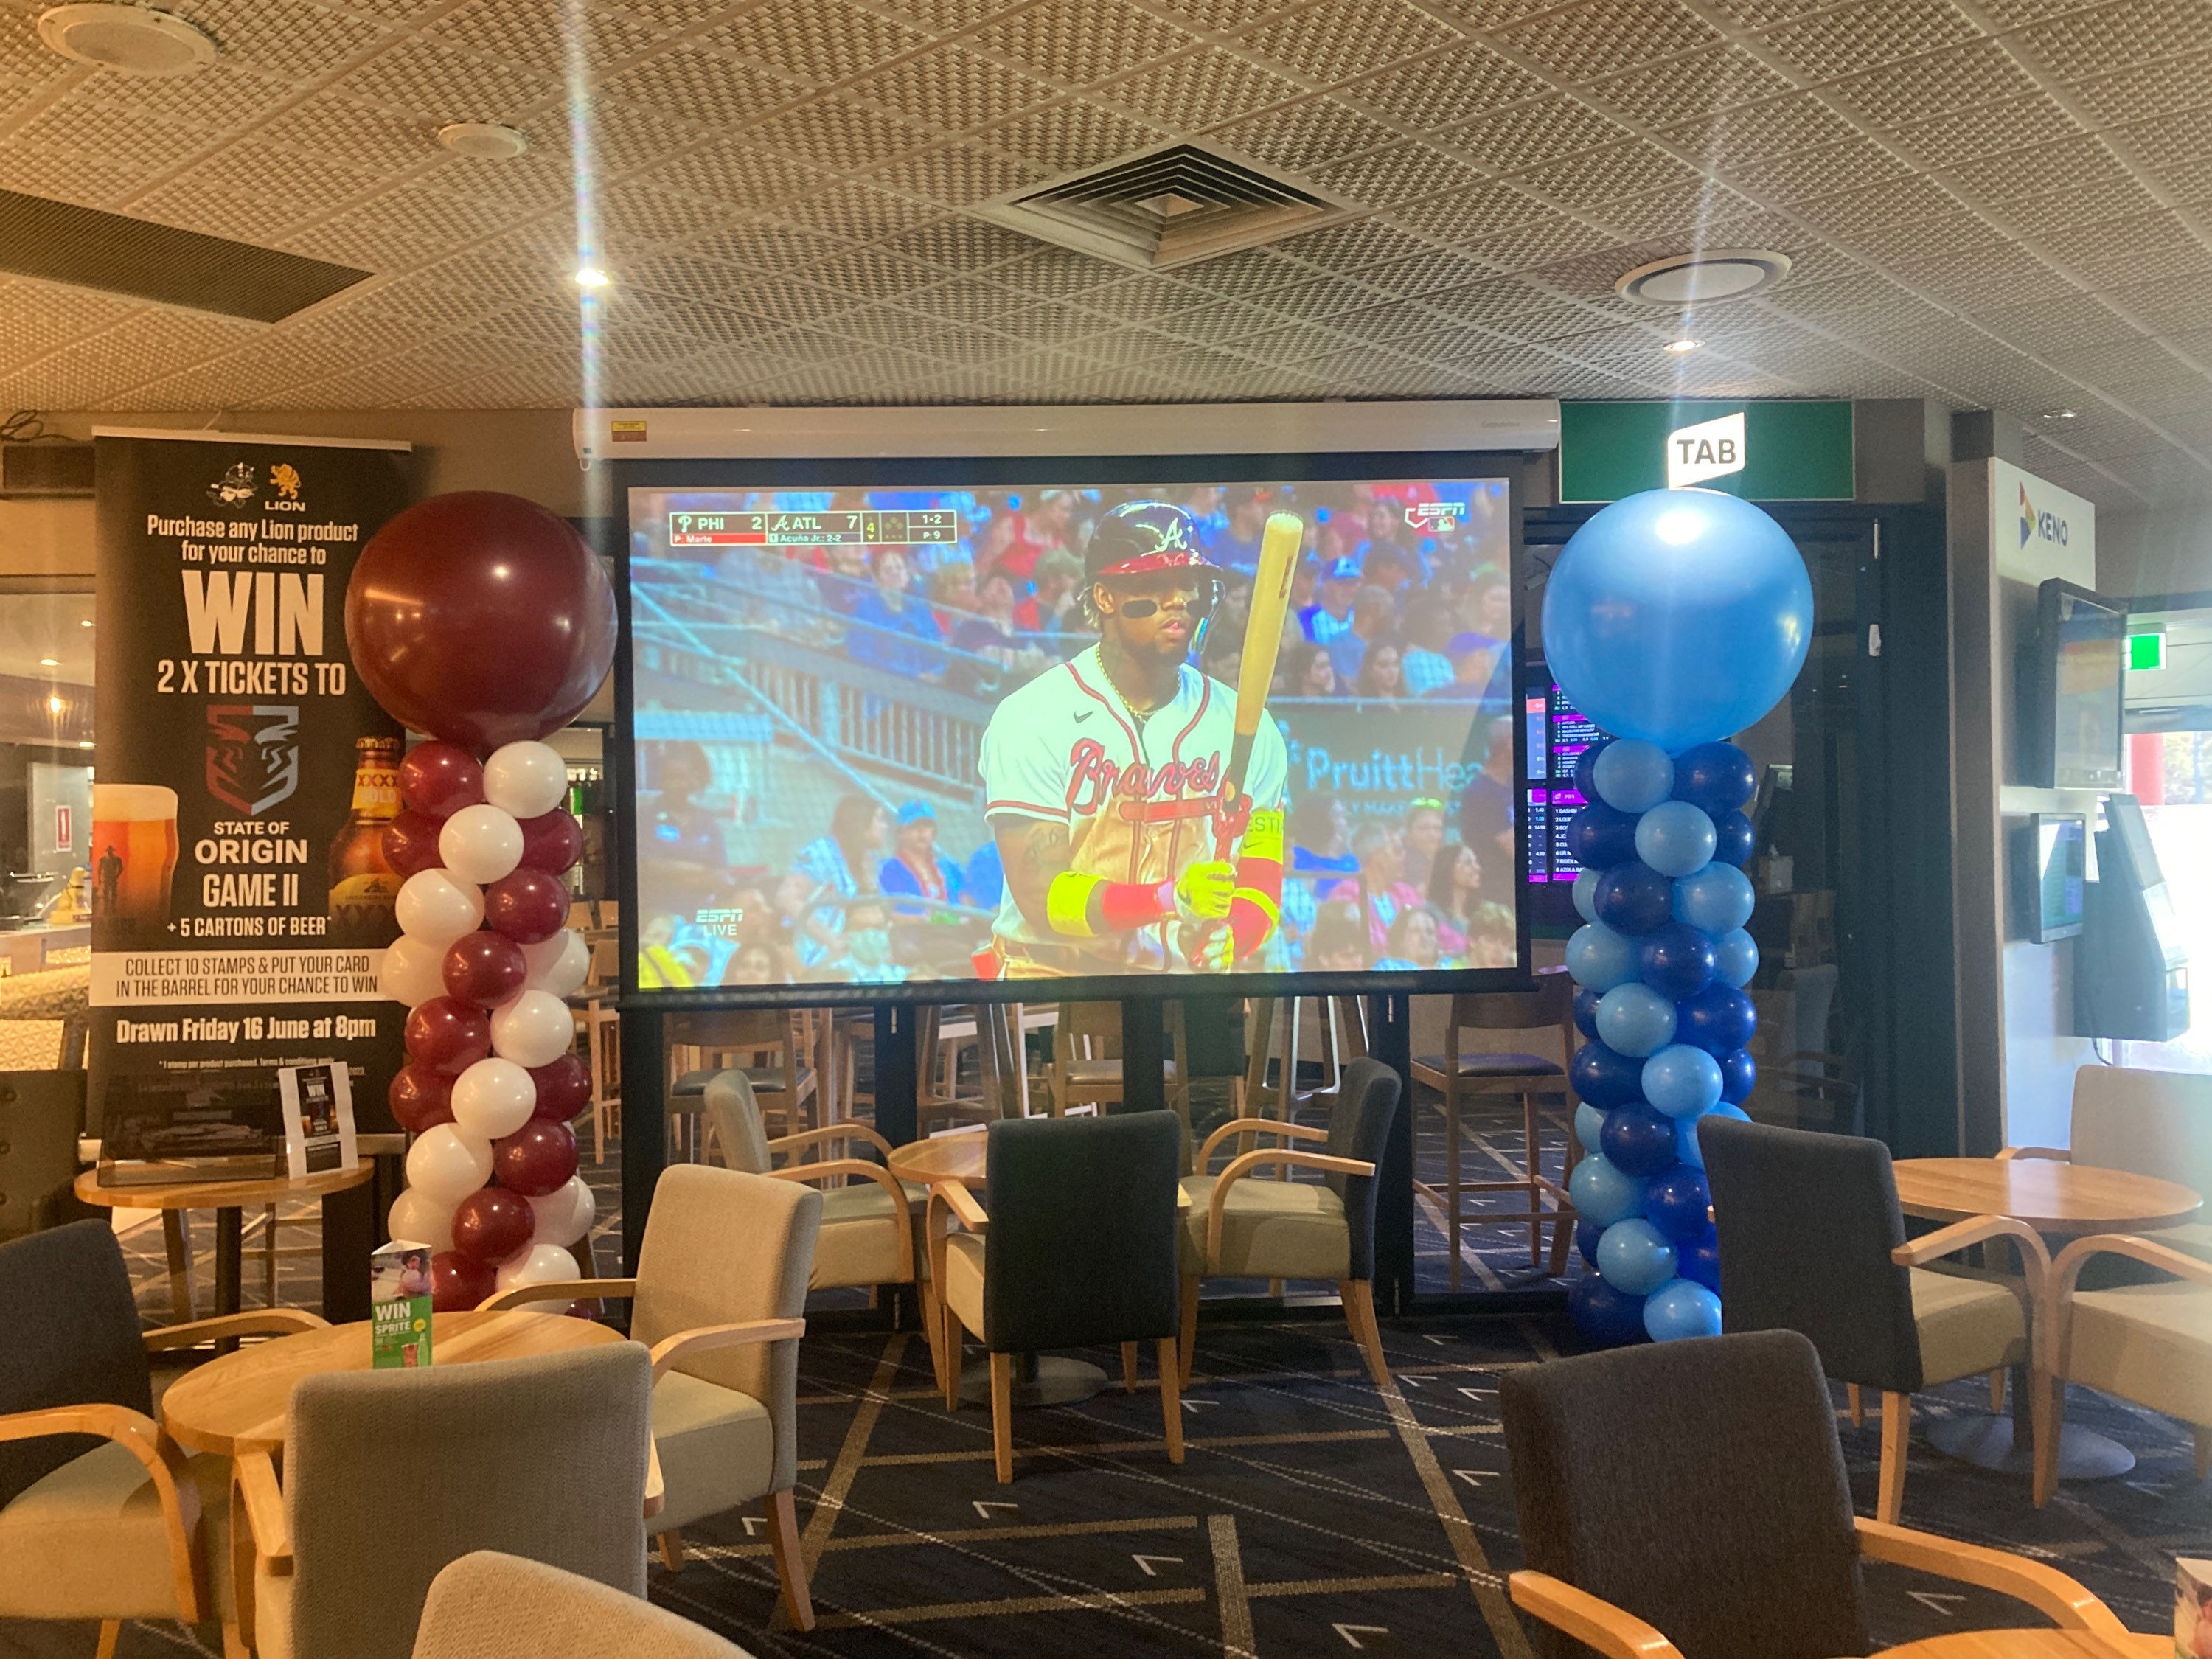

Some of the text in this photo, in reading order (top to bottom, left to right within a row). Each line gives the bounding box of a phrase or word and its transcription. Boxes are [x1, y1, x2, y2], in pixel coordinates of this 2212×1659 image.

[1677, 438, 1736, 465] TAB
[265, 500, 306, 512] LION
[1417, 502, 1465, 516] ESPN
[147, 514, 359, 543] Purchase any Lion product
[698, 517, 724, 530] PHI
[751, 516, 762, 530] 2
[792, 517, 821, 530] ATL
[846, 515, 858, 529] 7
[866, 522, 875, 532] 4
[922, 514, 942, 524] 1-2
[2037, 509, 2067, 546] KENO
[780, 534, 808, 543] Acuña
[933, 530, 941, 539] 9
[181, 540, 327, 565] for your chance to
[181, 569, 324, 656] WIN
[157, 659, 346, 695] 2 X TICKETS TO
[1065, 737, 1220, 815] Braves
[214, 821, 290, 835] STATE OF
[195, 839, 307, 865] ORIGIN
[203, 874, 299, 908] GAME II
[695, 908, 744, 922] ESPN
[180, 918, 189, 936] 5
[195, 917, 265, 936] CARTONS
[269, 917, 287, 936] OF
[703, 924, 737, 936] LIVE
[125, 955, 370, 977] COLLECT 10 STAMPS & PUT YOUR CARD
[116, 975, 378, 998] IN THE BARREL FOR YOUR CHANCE TO WIN
[116, 1015, 376, 1044] Drawn Friday 16 June at 8pm
[375, 1301, 411, 1321] WIN
[375, 1321, 411, 1335] SPRITE
